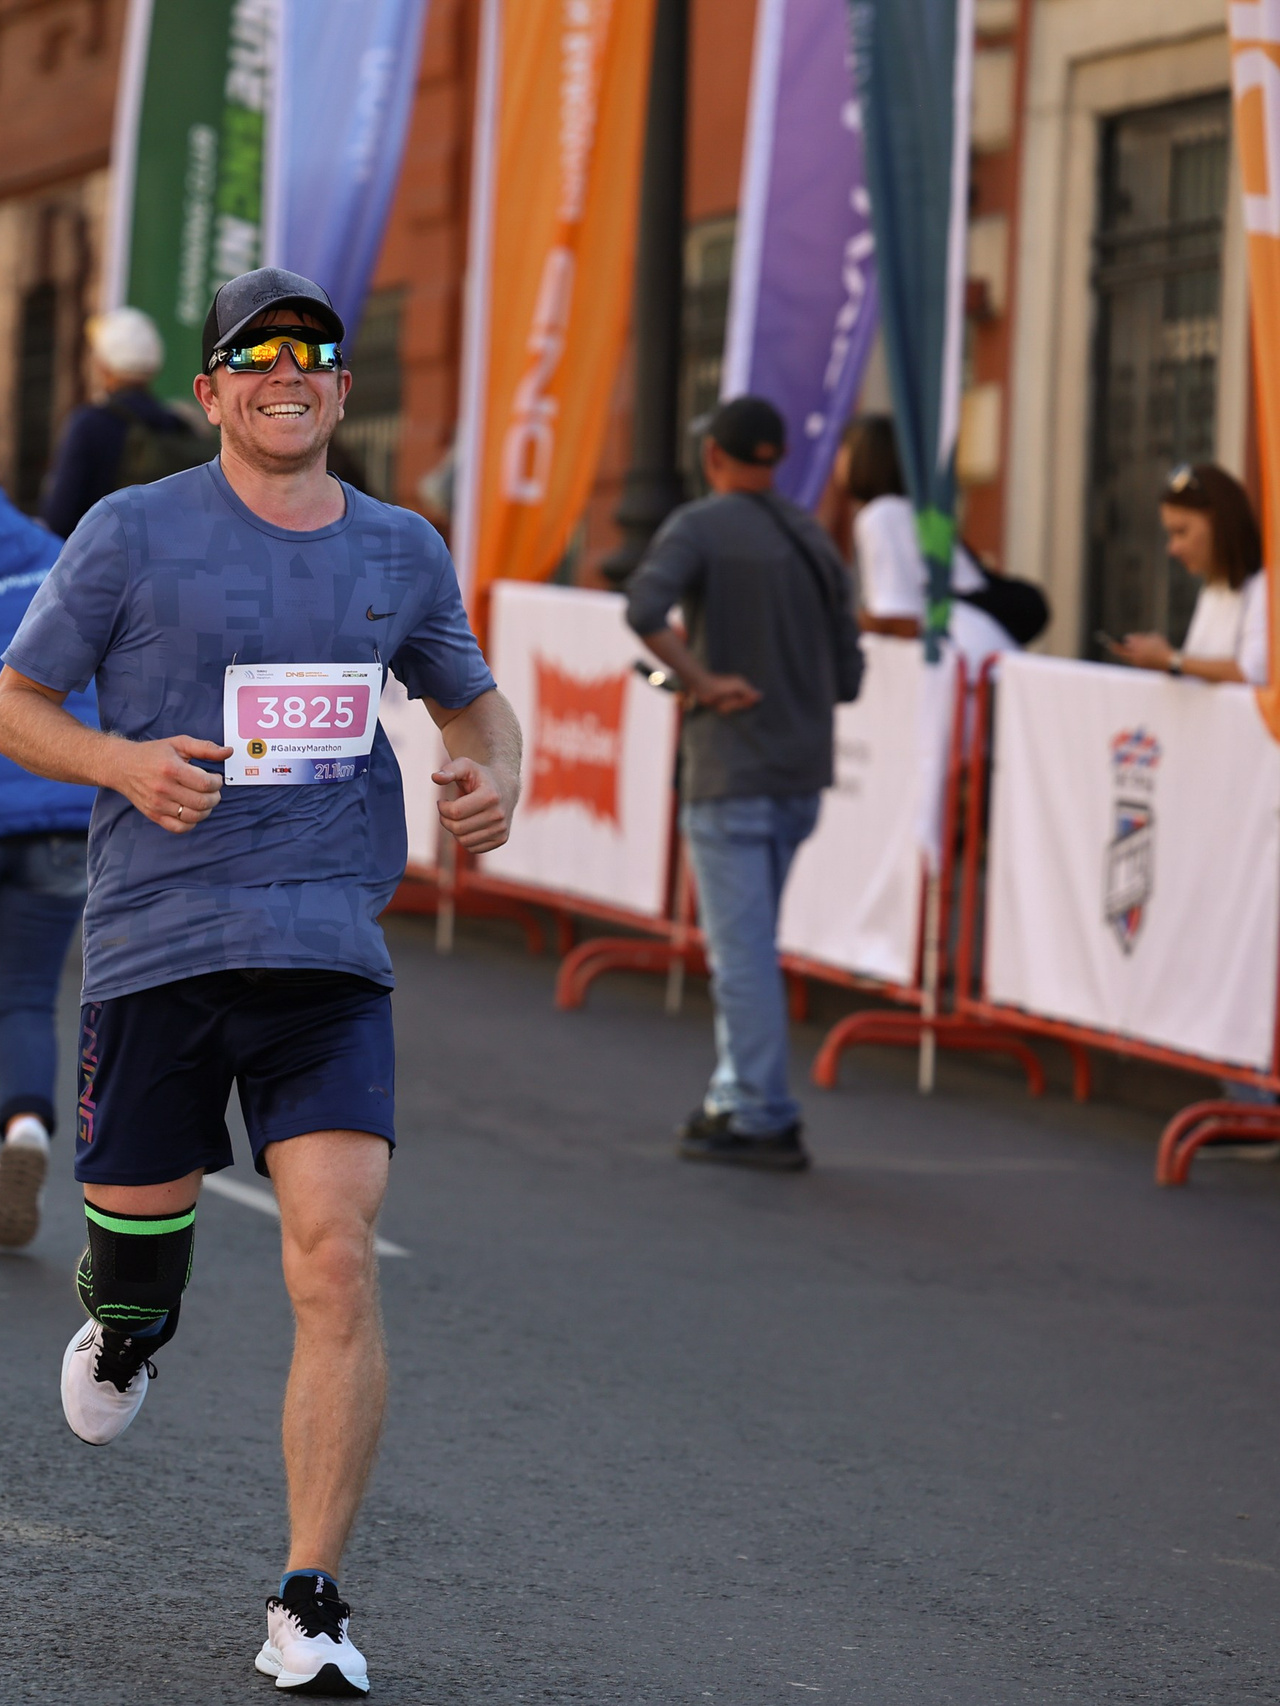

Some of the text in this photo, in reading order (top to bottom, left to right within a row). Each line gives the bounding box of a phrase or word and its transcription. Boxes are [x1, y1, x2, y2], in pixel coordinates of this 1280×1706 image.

[256, 696, 354, 729] 3825
[251, 742, 263, 754] B
[270, 743, 342, 753] #GalaxyMarathon
